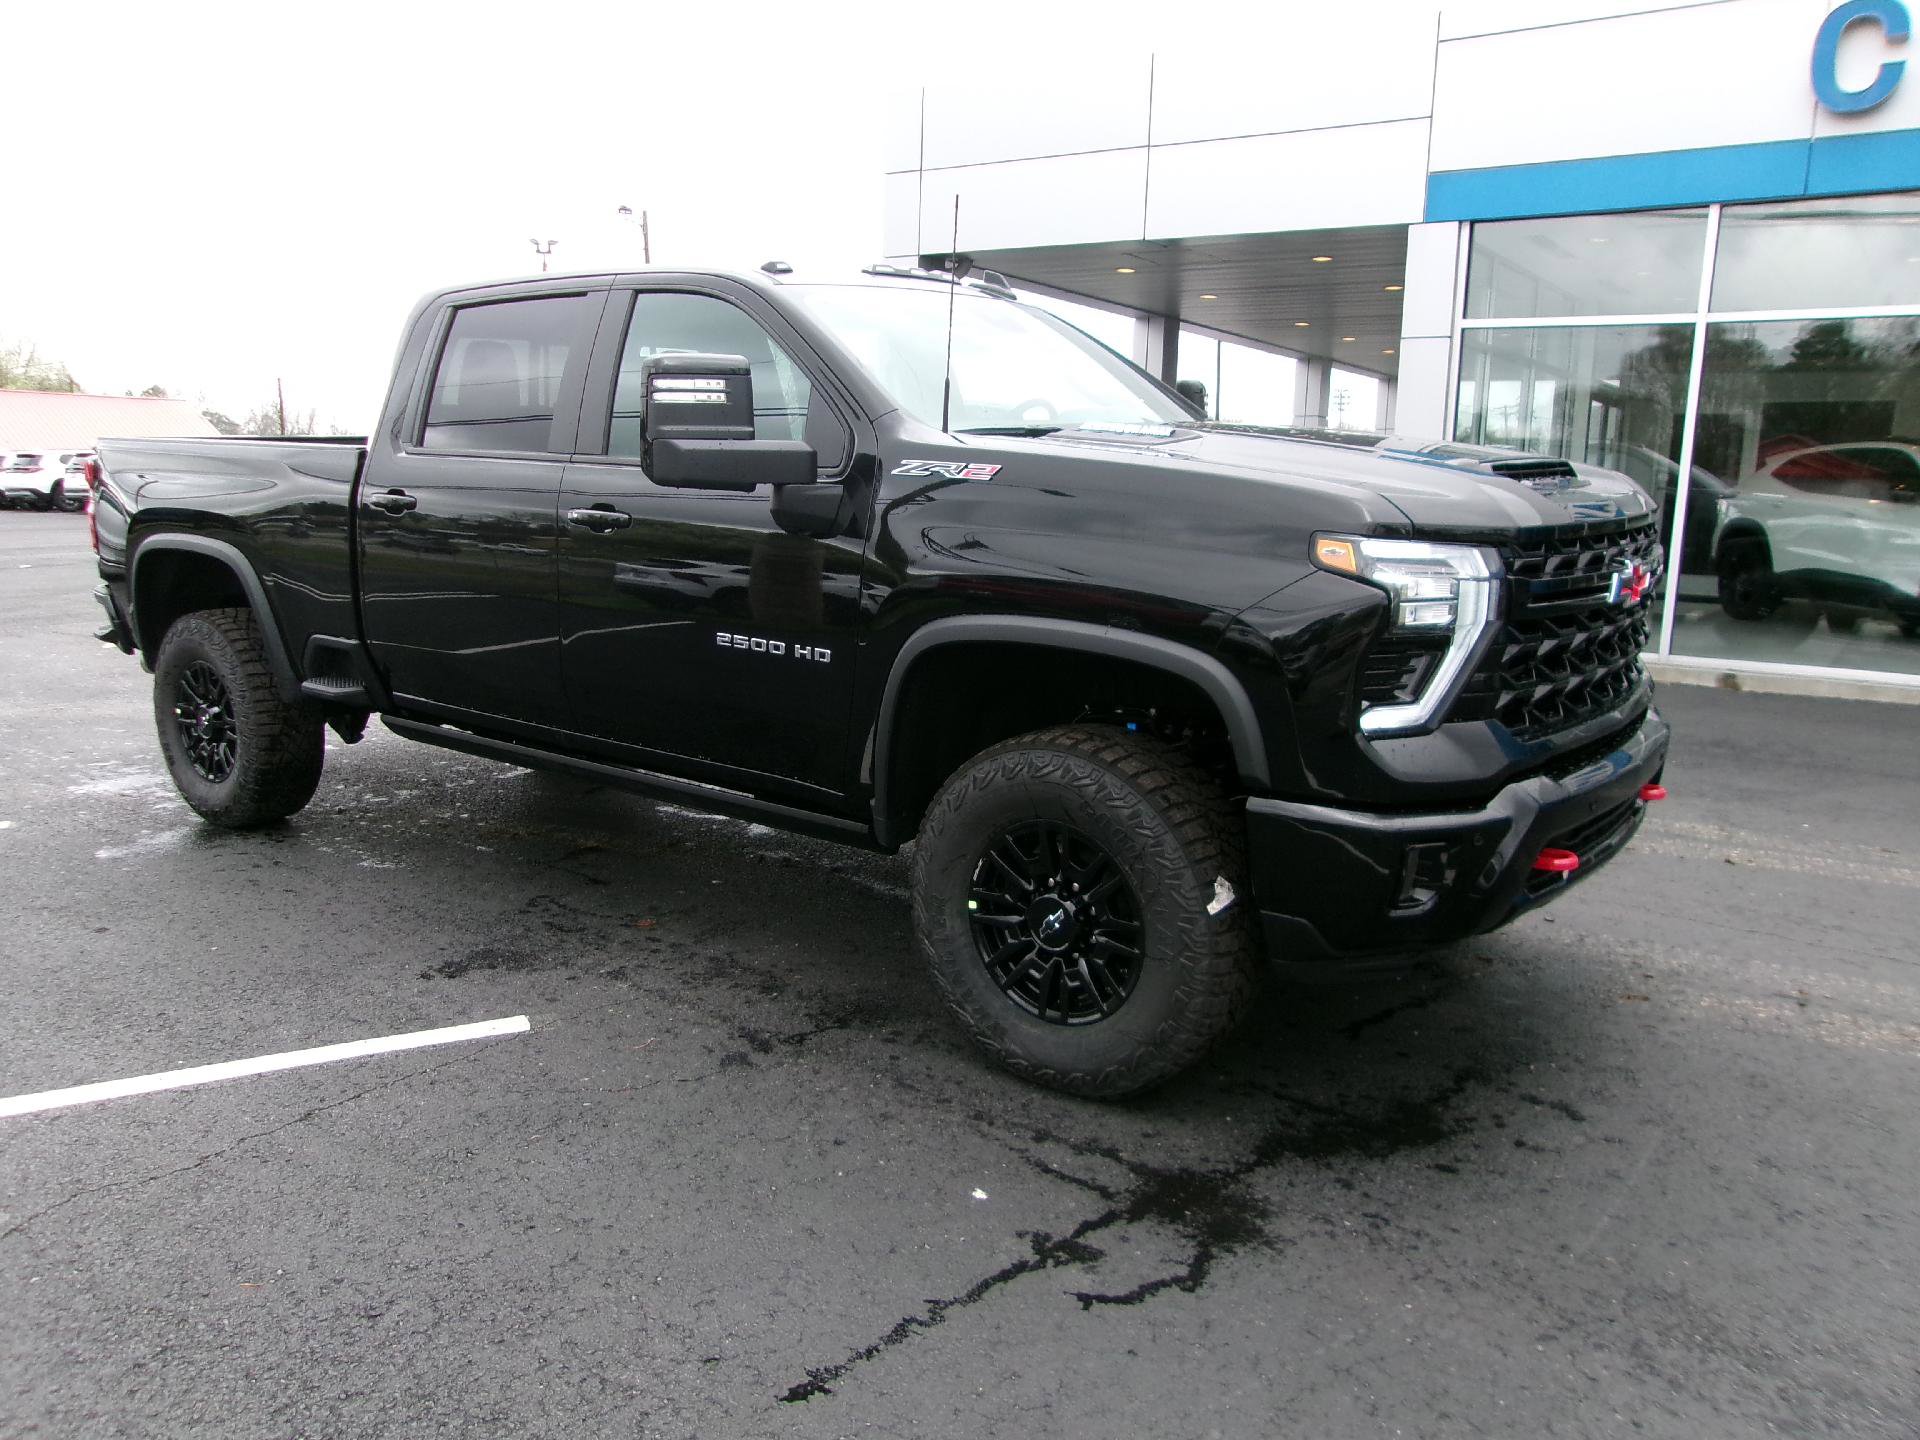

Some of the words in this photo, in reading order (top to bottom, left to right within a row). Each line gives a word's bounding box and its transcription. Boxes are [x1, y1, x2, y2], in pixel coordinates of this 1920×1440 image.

[1811, 0, 1909, 116] C
[891, 459, 1003, 481] ZR2
[716, 632, 785, 655] 2500
[795, 644, 832, 663] HD
